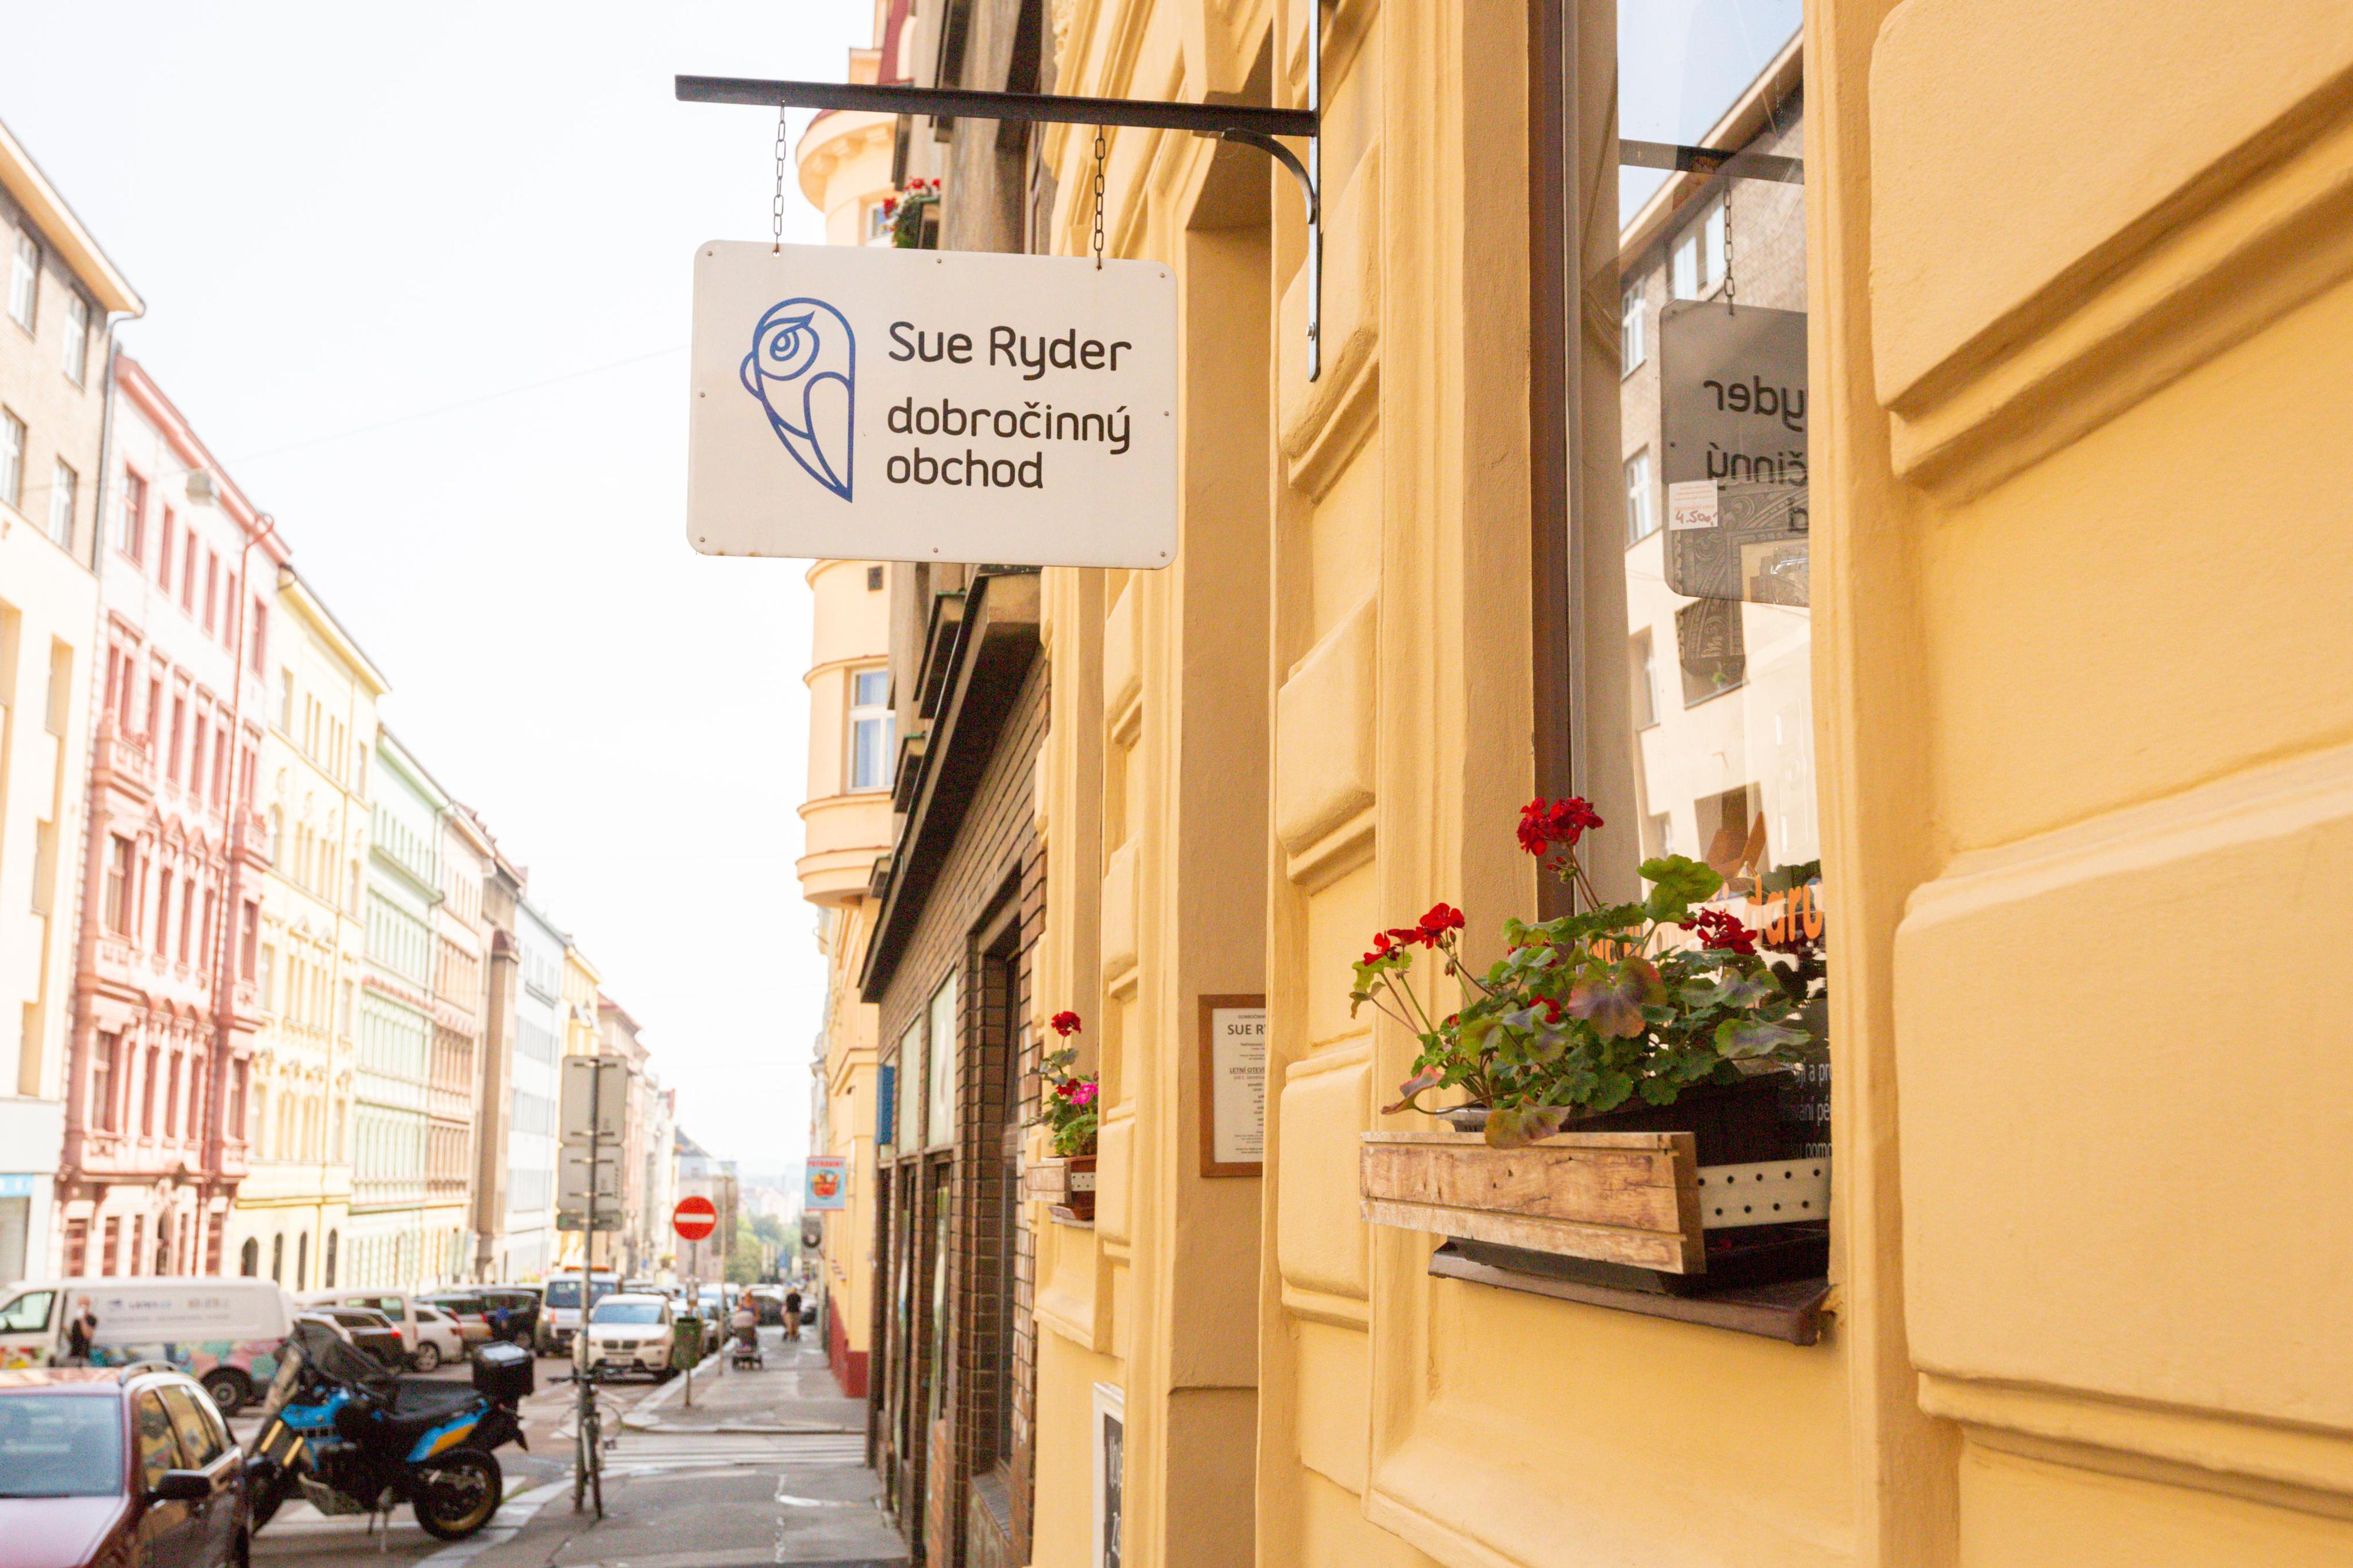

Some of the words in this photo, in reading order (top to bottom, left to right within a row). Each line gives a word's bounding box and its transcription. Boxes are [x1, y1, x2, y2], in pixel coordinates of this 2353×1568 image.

[888, 321, 973, 364] Sue
[990, 325, 1132, 381] Ryder
[888, 396, 1131, 455] dobročinný
[887, 448, 1044, 489] obchod
[1227, 1024, 1252, 1035] SUE
[1256, 1024, 1266, 1035] R
[1229, 1066, 1246, 1074] LETNÍ
